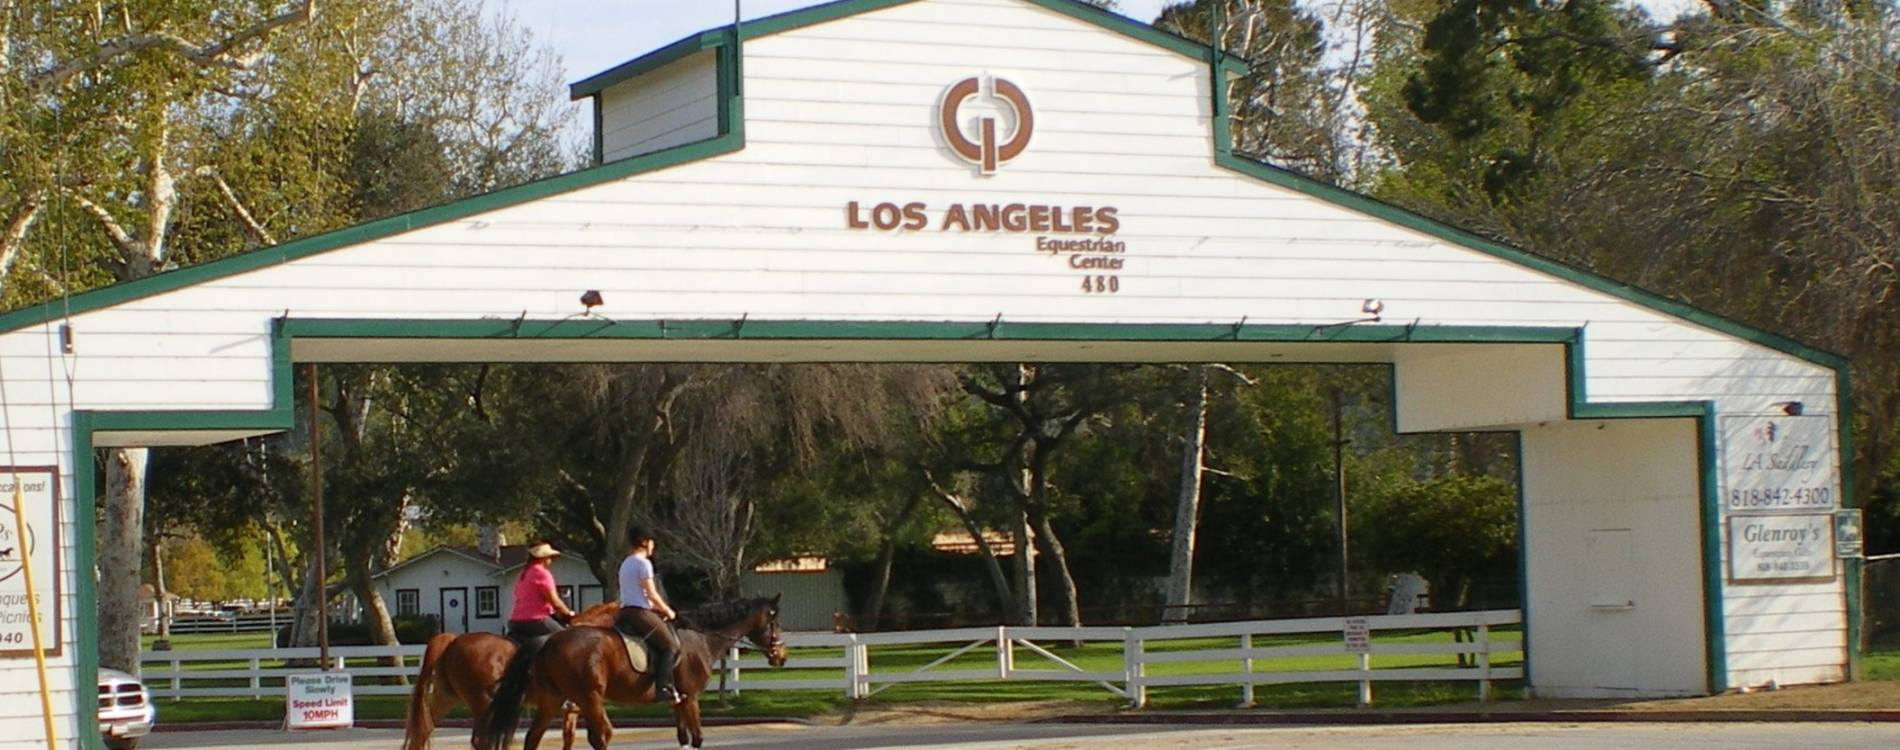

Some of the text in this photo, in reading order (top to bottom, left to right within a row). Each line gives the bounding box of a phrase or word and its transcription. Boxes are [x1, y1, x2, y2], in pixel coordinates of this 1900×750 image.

[848, 201, 1119, 234] LOS ANGELES
[1036, 236, 1125, 255] Equestrian
[1069, 254, 1124, 270] Center
[1081, 275, 1119, 293] 480
[1731, 486, 1829, 507] 818-842-4300
[1744, 522, 1820, 546] Glenroy's
[291, 675, 349, 685] Please Drive
[305, 685, 336, 695] Slowly
[293, 697, 348, 709] Speed Limit
[303, 710, 338, 720] 10MPH
